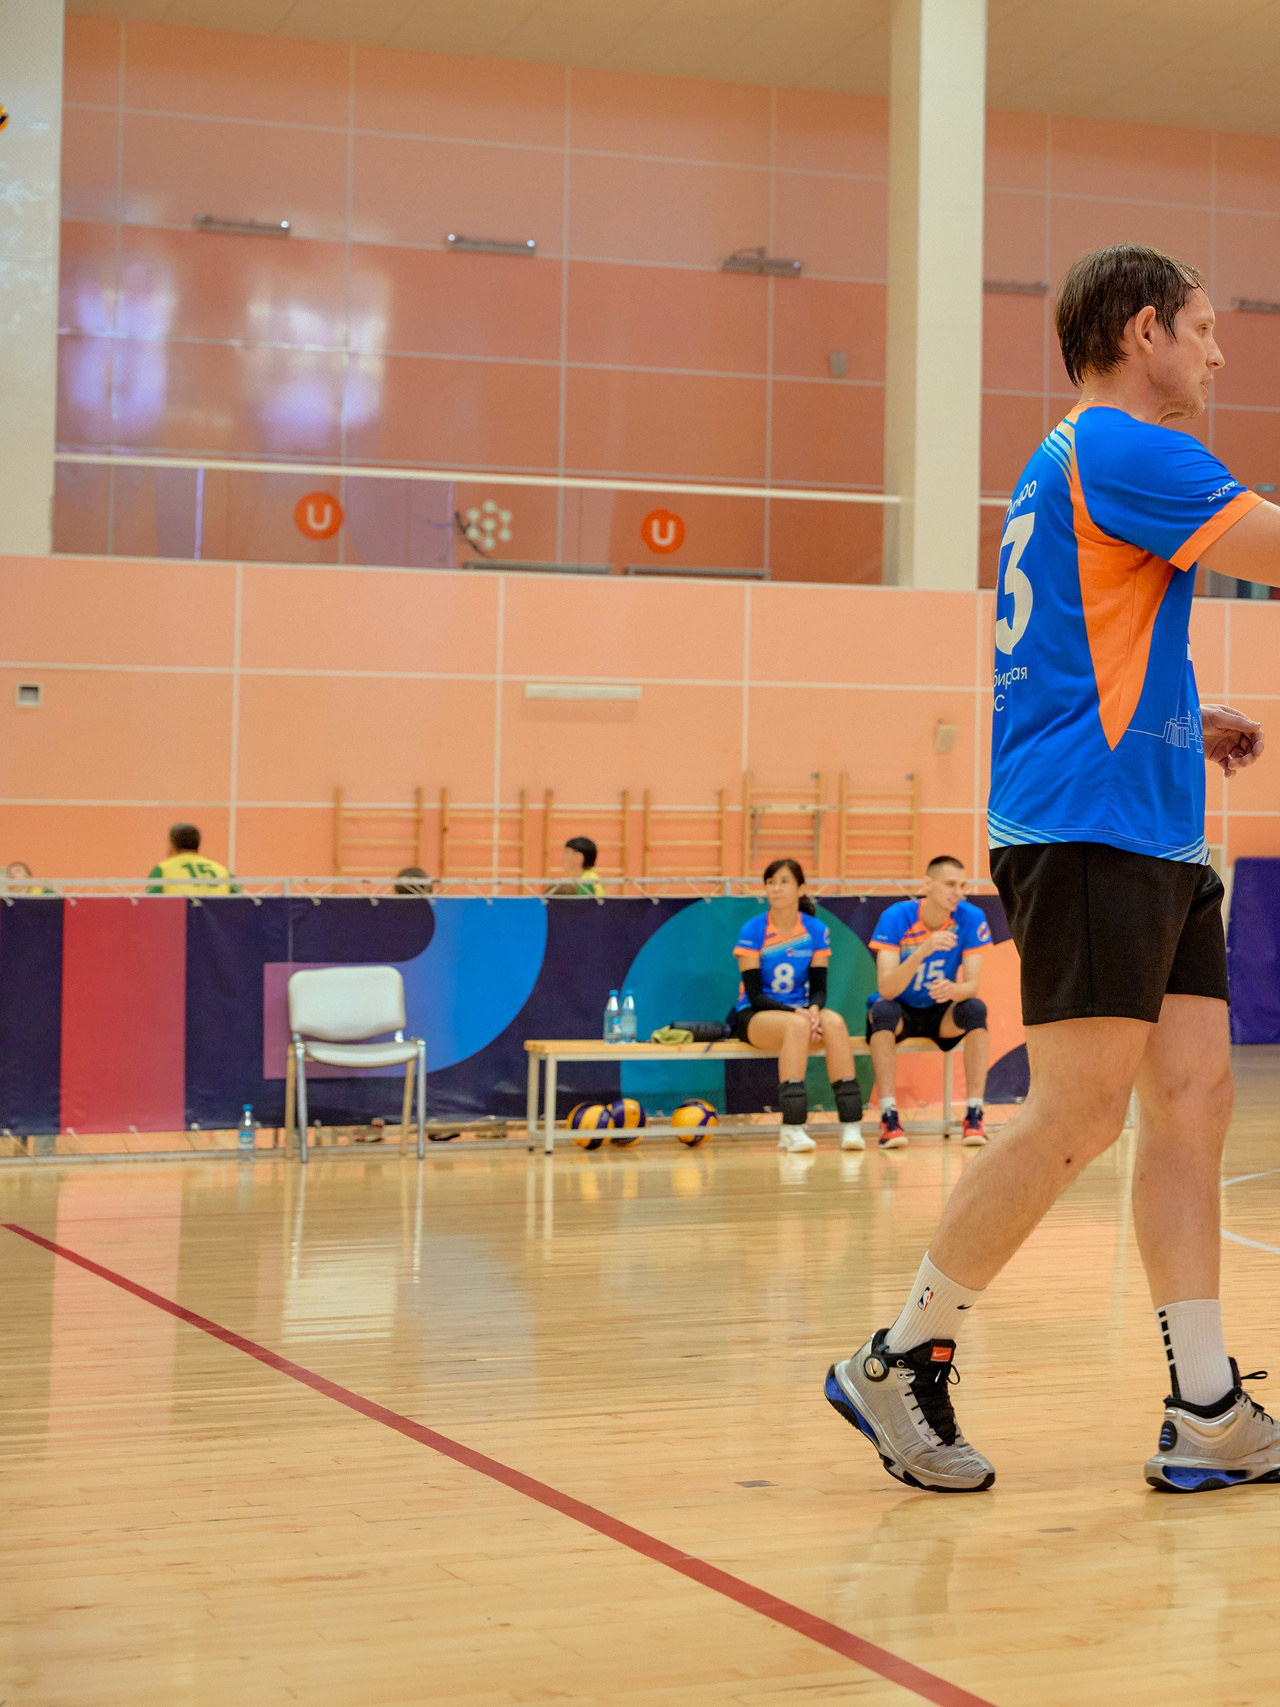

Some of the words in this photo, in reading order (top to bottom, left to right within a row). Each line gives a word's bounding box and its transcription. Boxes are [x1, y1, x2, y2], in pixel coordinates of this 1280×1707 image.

[308, 503, 331, 530] U
[652, 519, 675, 546] U
[995, 511, 1036, 656] 3
[770, 962, 795, 995] 8
[913, 958, 946, 992] 15
